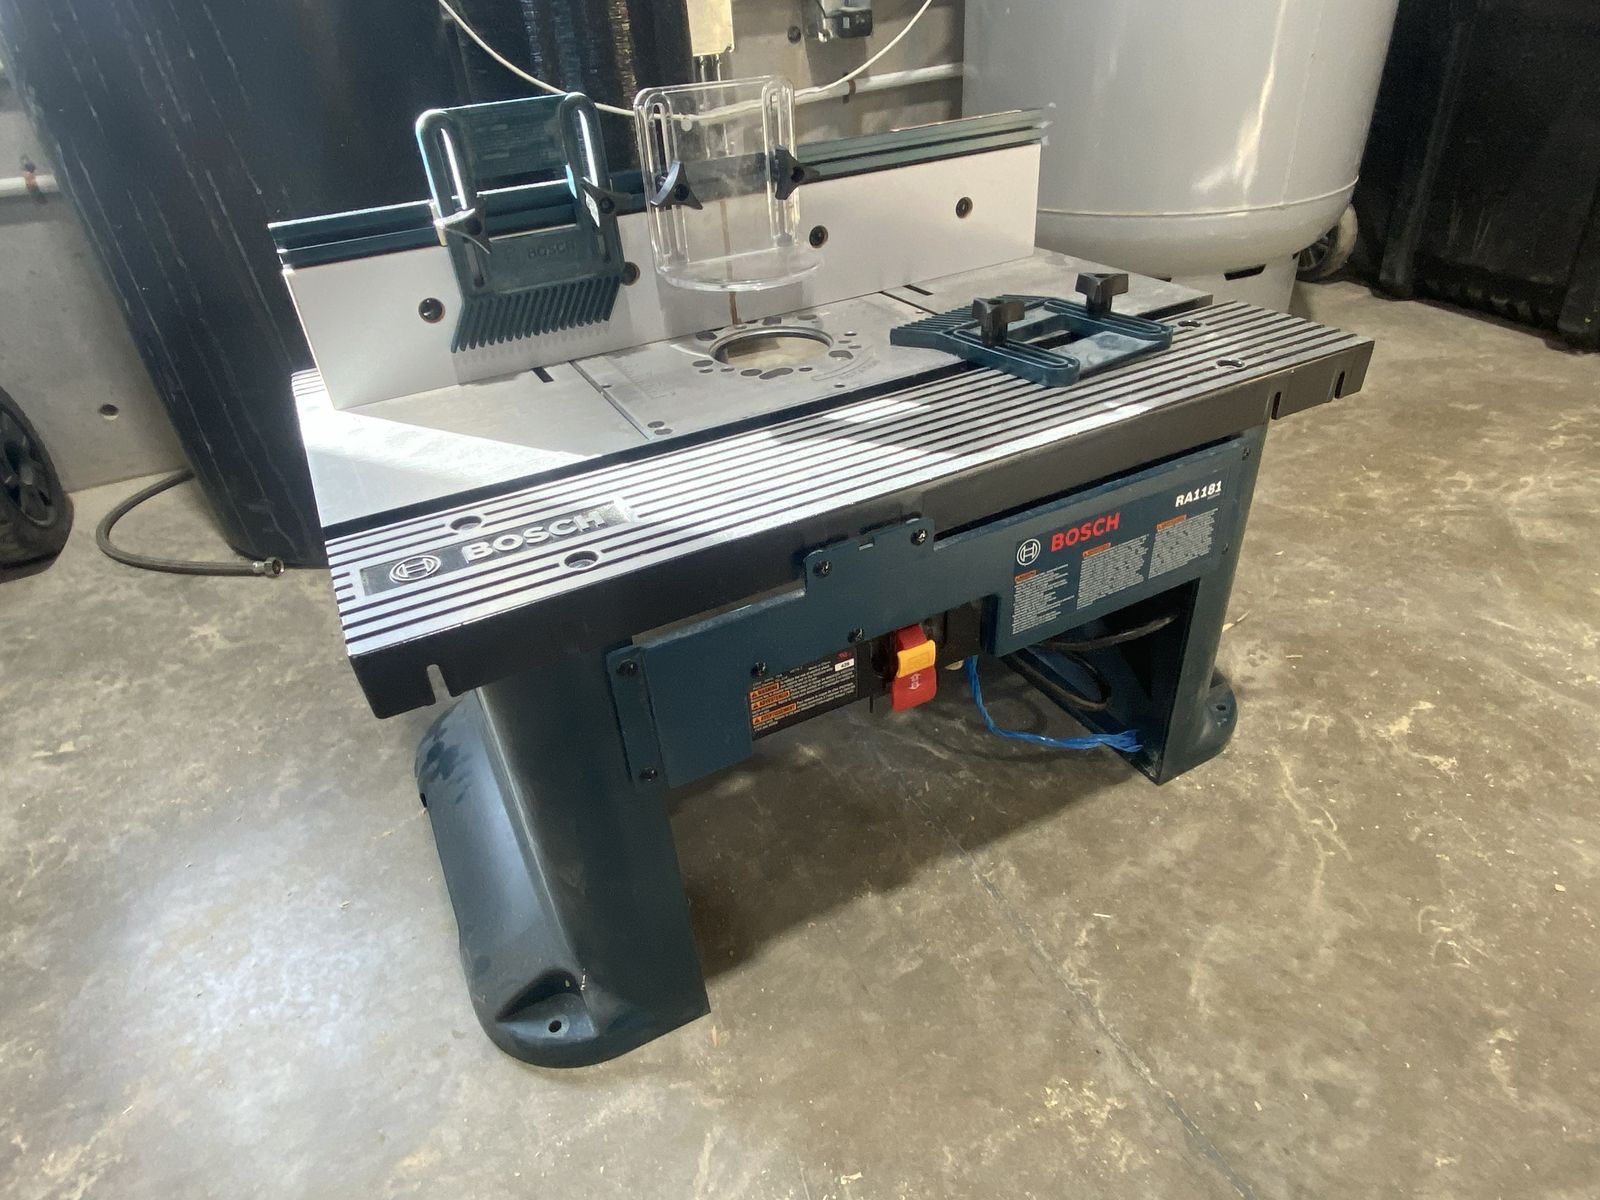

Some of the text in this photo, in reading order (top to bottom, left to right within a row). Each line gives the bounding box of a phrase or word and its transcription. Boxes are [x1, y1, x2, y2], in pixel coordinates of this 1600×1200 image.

[1175, 480, 1222, 508] RA1181
[461, 510, 605, 563] BOSCH
[1051, 512, 1120, 552] BOSCH
